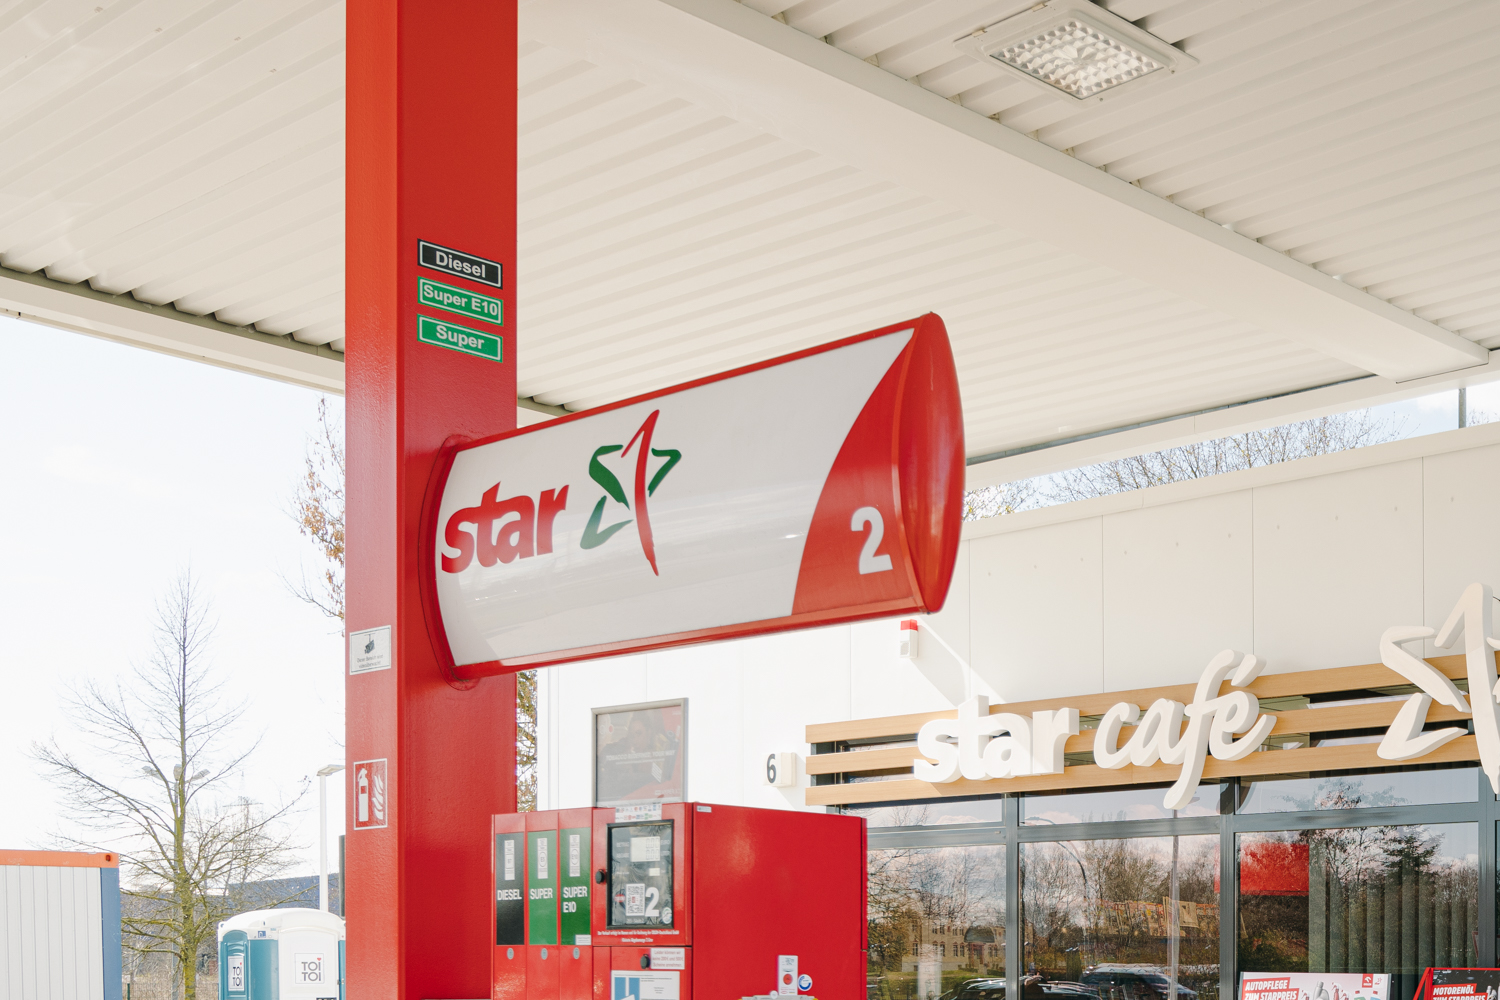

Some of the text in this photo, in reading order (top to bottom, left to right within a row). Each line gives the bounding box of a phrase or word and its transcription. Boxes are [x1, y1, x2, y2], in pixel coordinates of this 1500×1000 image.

[435, 250, 486, 279] Diesel
[423, 284, 498, 316] Super E10
[435, 324, 485, 350] Super
[441, 481, 569, 574] star
[850, 507, 892, 575] 2
[914, 648, 1277, 811] star café
[766, 754, 778, 783] 6
[497, 889, 523, 901] DIESEL
[529, 887, 554, 900] SUPER
[562, 886, 589, 899] SUPER
[644, 886, 661, 918] 2
[562, 901, 577, 913] E10
[301, 971, 322, 982] TOI
[1245, 979, 1288, 991] AUTOPFLEGE
[1433, 984, 1474, 996] MOTORENÖL
